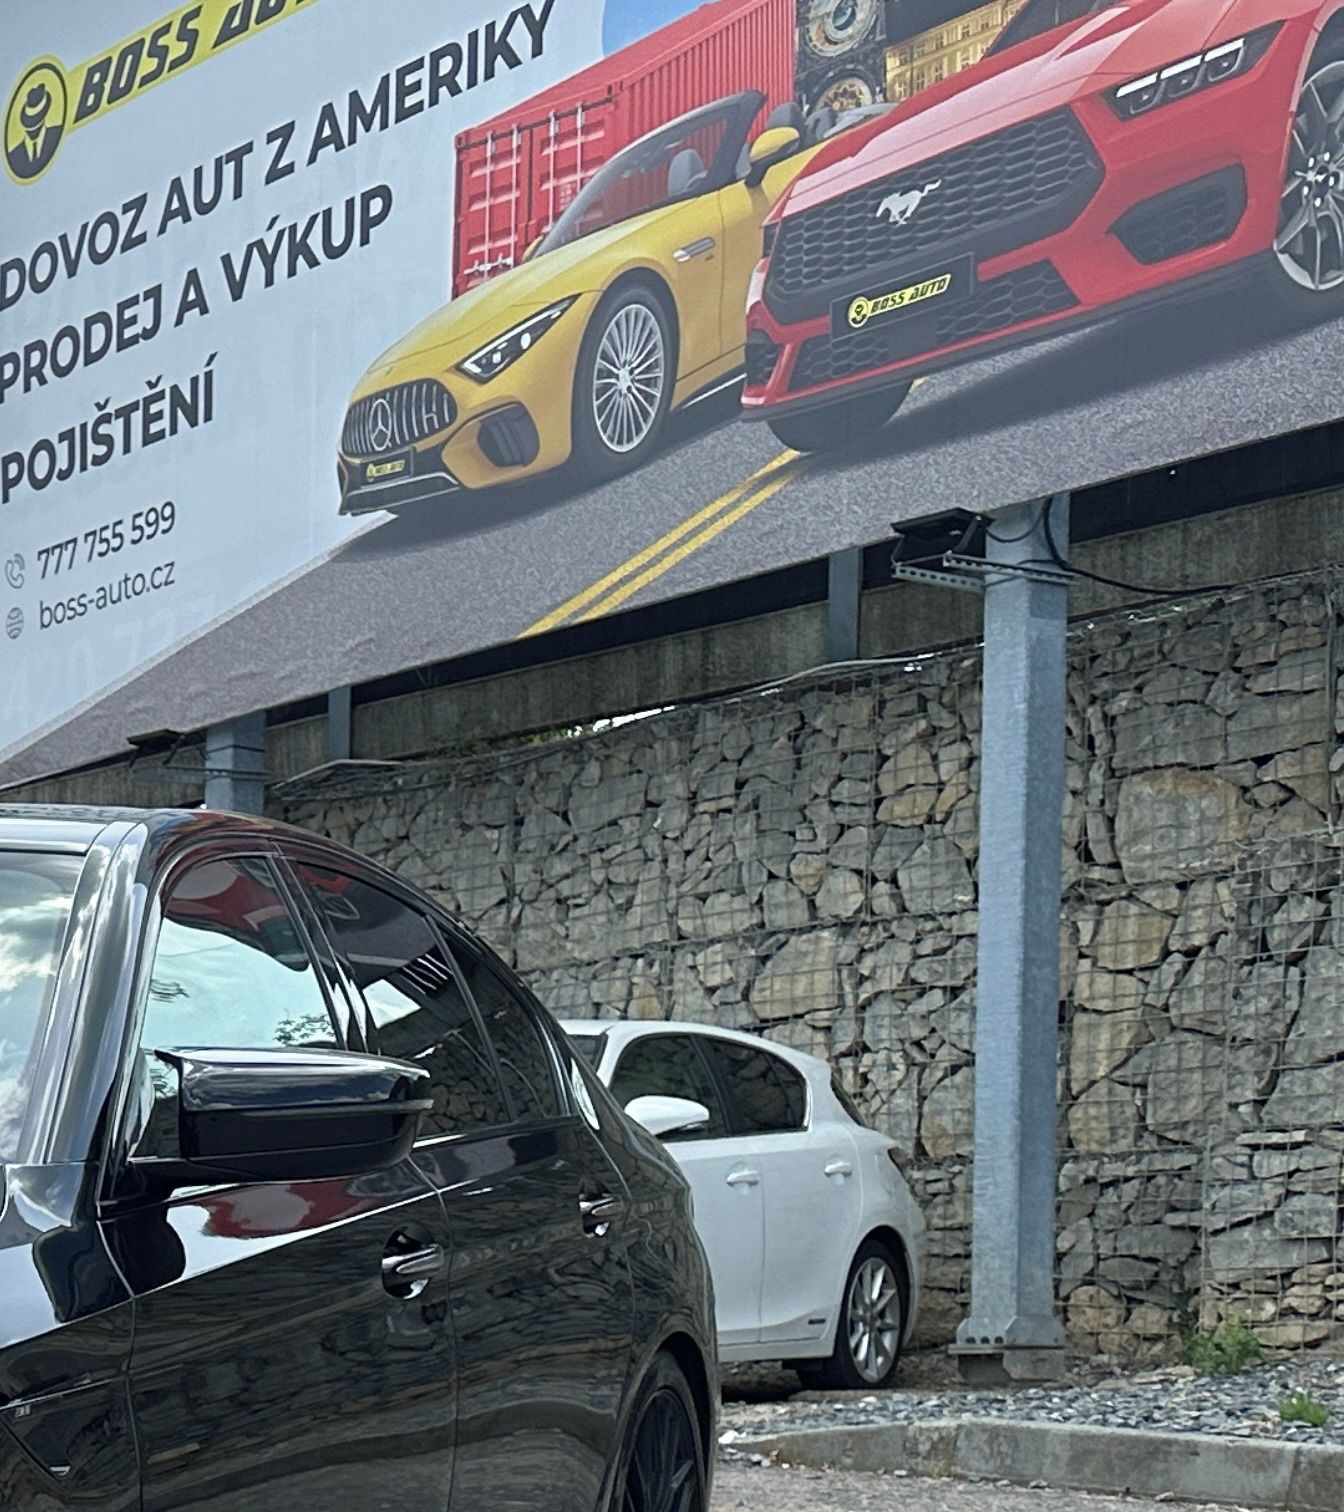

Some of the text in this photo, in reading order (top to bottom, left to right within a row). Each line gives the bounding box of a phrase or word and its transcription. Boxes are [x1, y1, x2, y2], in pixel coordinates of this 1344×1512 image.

[72, 4, 204, 125] BOSS
[157, 140, 254, 237] AUT
[263, 119, 297, 186] Z
[305, 0, 556, 166] AMERIKY
[174, 266, 210, 327] A
[219, 183, 394, 303] VÝKUP
[871, 277, 948, 313] BOSS AUTO
[0, 352, 219, 505] POJIŠTĚNÍ
[37, 501, 176, 580] 777 755 599
[38, 561, 177, 631] boss-auto.cz
